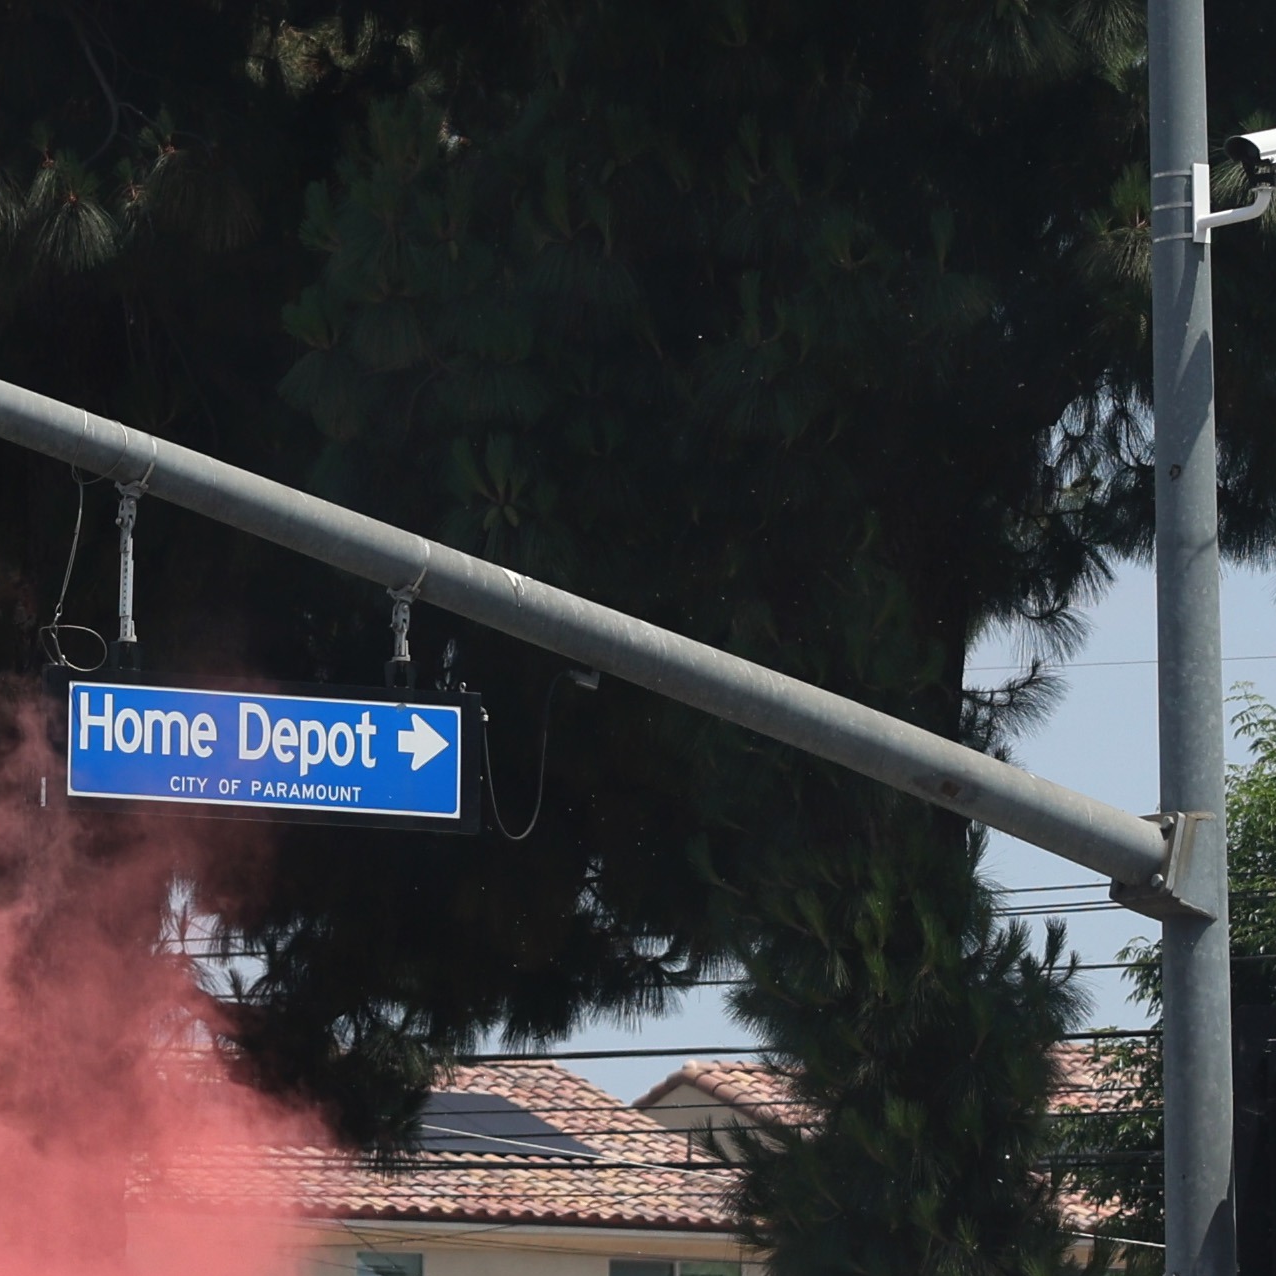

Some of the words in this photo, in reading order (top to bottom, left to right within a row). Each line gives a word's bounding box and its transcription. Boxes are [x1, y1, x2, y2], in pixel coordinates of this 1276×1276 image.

[79, 692, 217, 758] Home
[239, 702, 377, 777] Depot
[170, 776, 208, 793] CITY
[218, 779, 242, 795] OF
[251, 782, 361, 802] PARAMOUNT
